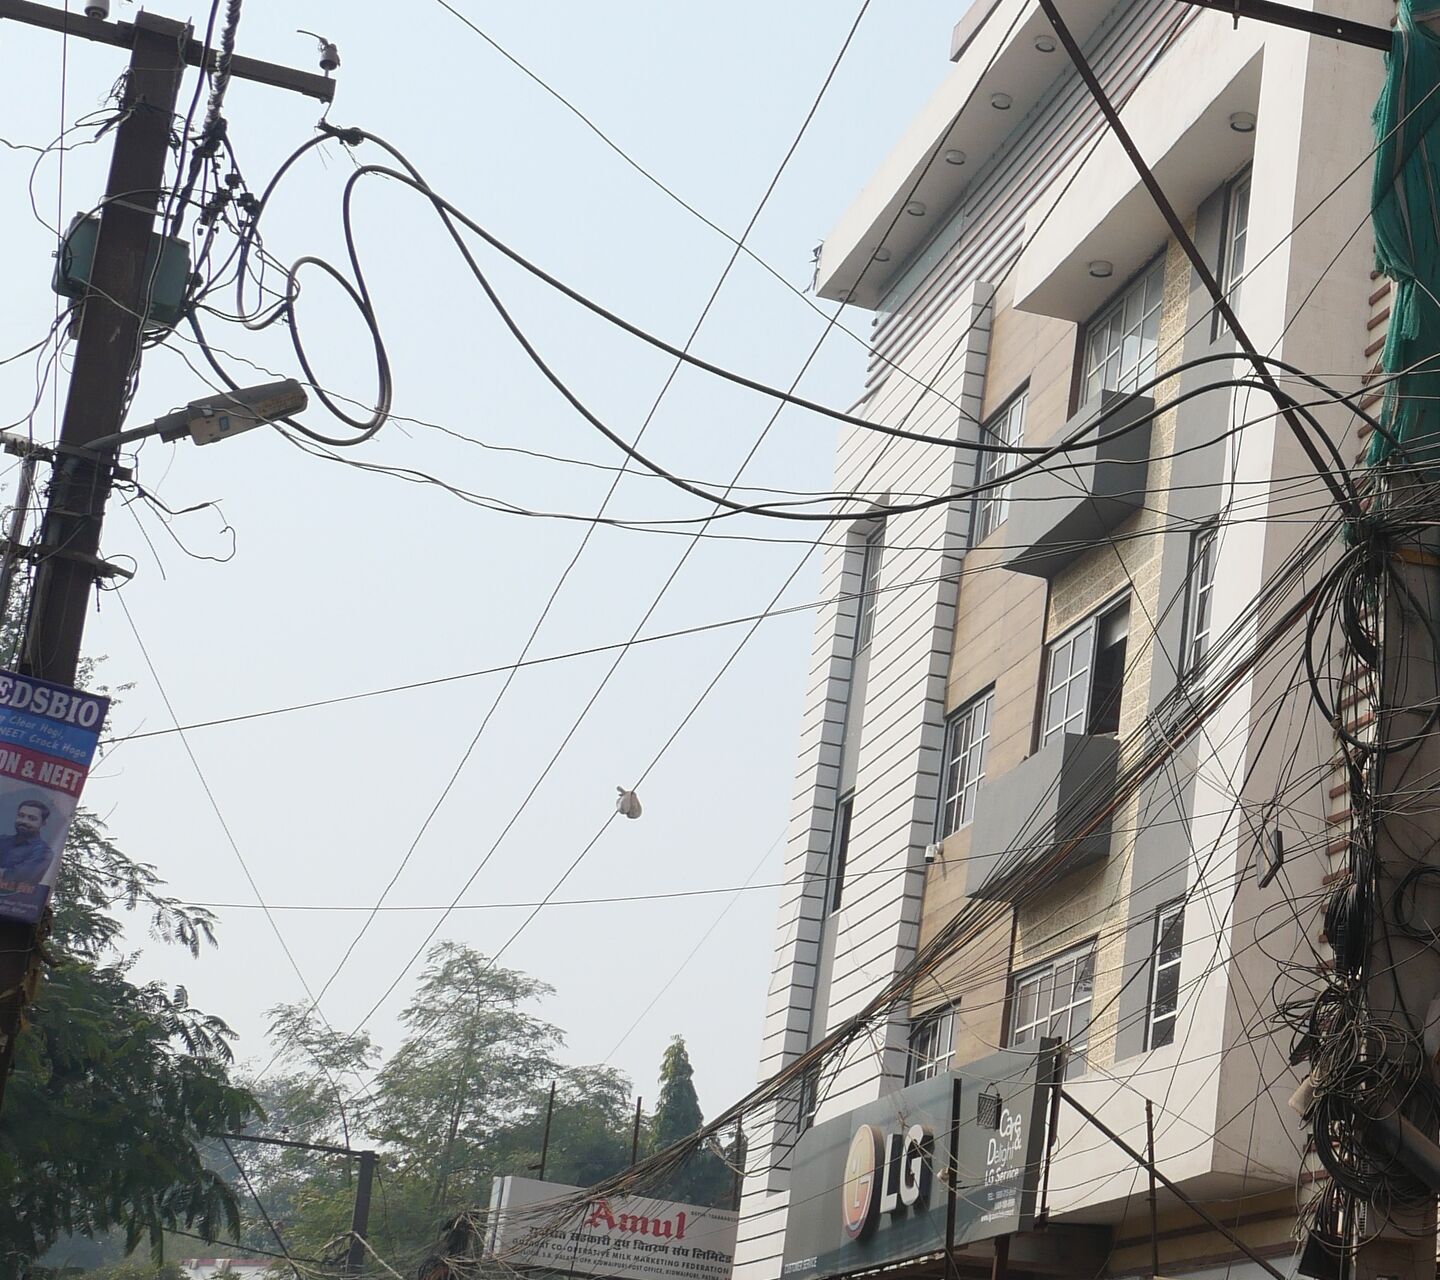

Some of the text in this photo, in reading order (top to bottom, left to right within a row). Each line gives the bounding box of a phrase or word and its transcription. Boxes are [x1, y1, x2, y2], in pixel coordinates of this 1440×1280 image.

[21, 760, 35, 778] &
[39, 761, 83, 791] NEET
[880, 1124, 935, 1214] LG
[584, 1200, 686, 1240] Amul
[612, 1252, 631, 1261] MILK
[634, 1255, 679, 1268] MARKETING
[682, 1260, 729, 1274] FEDERATION
